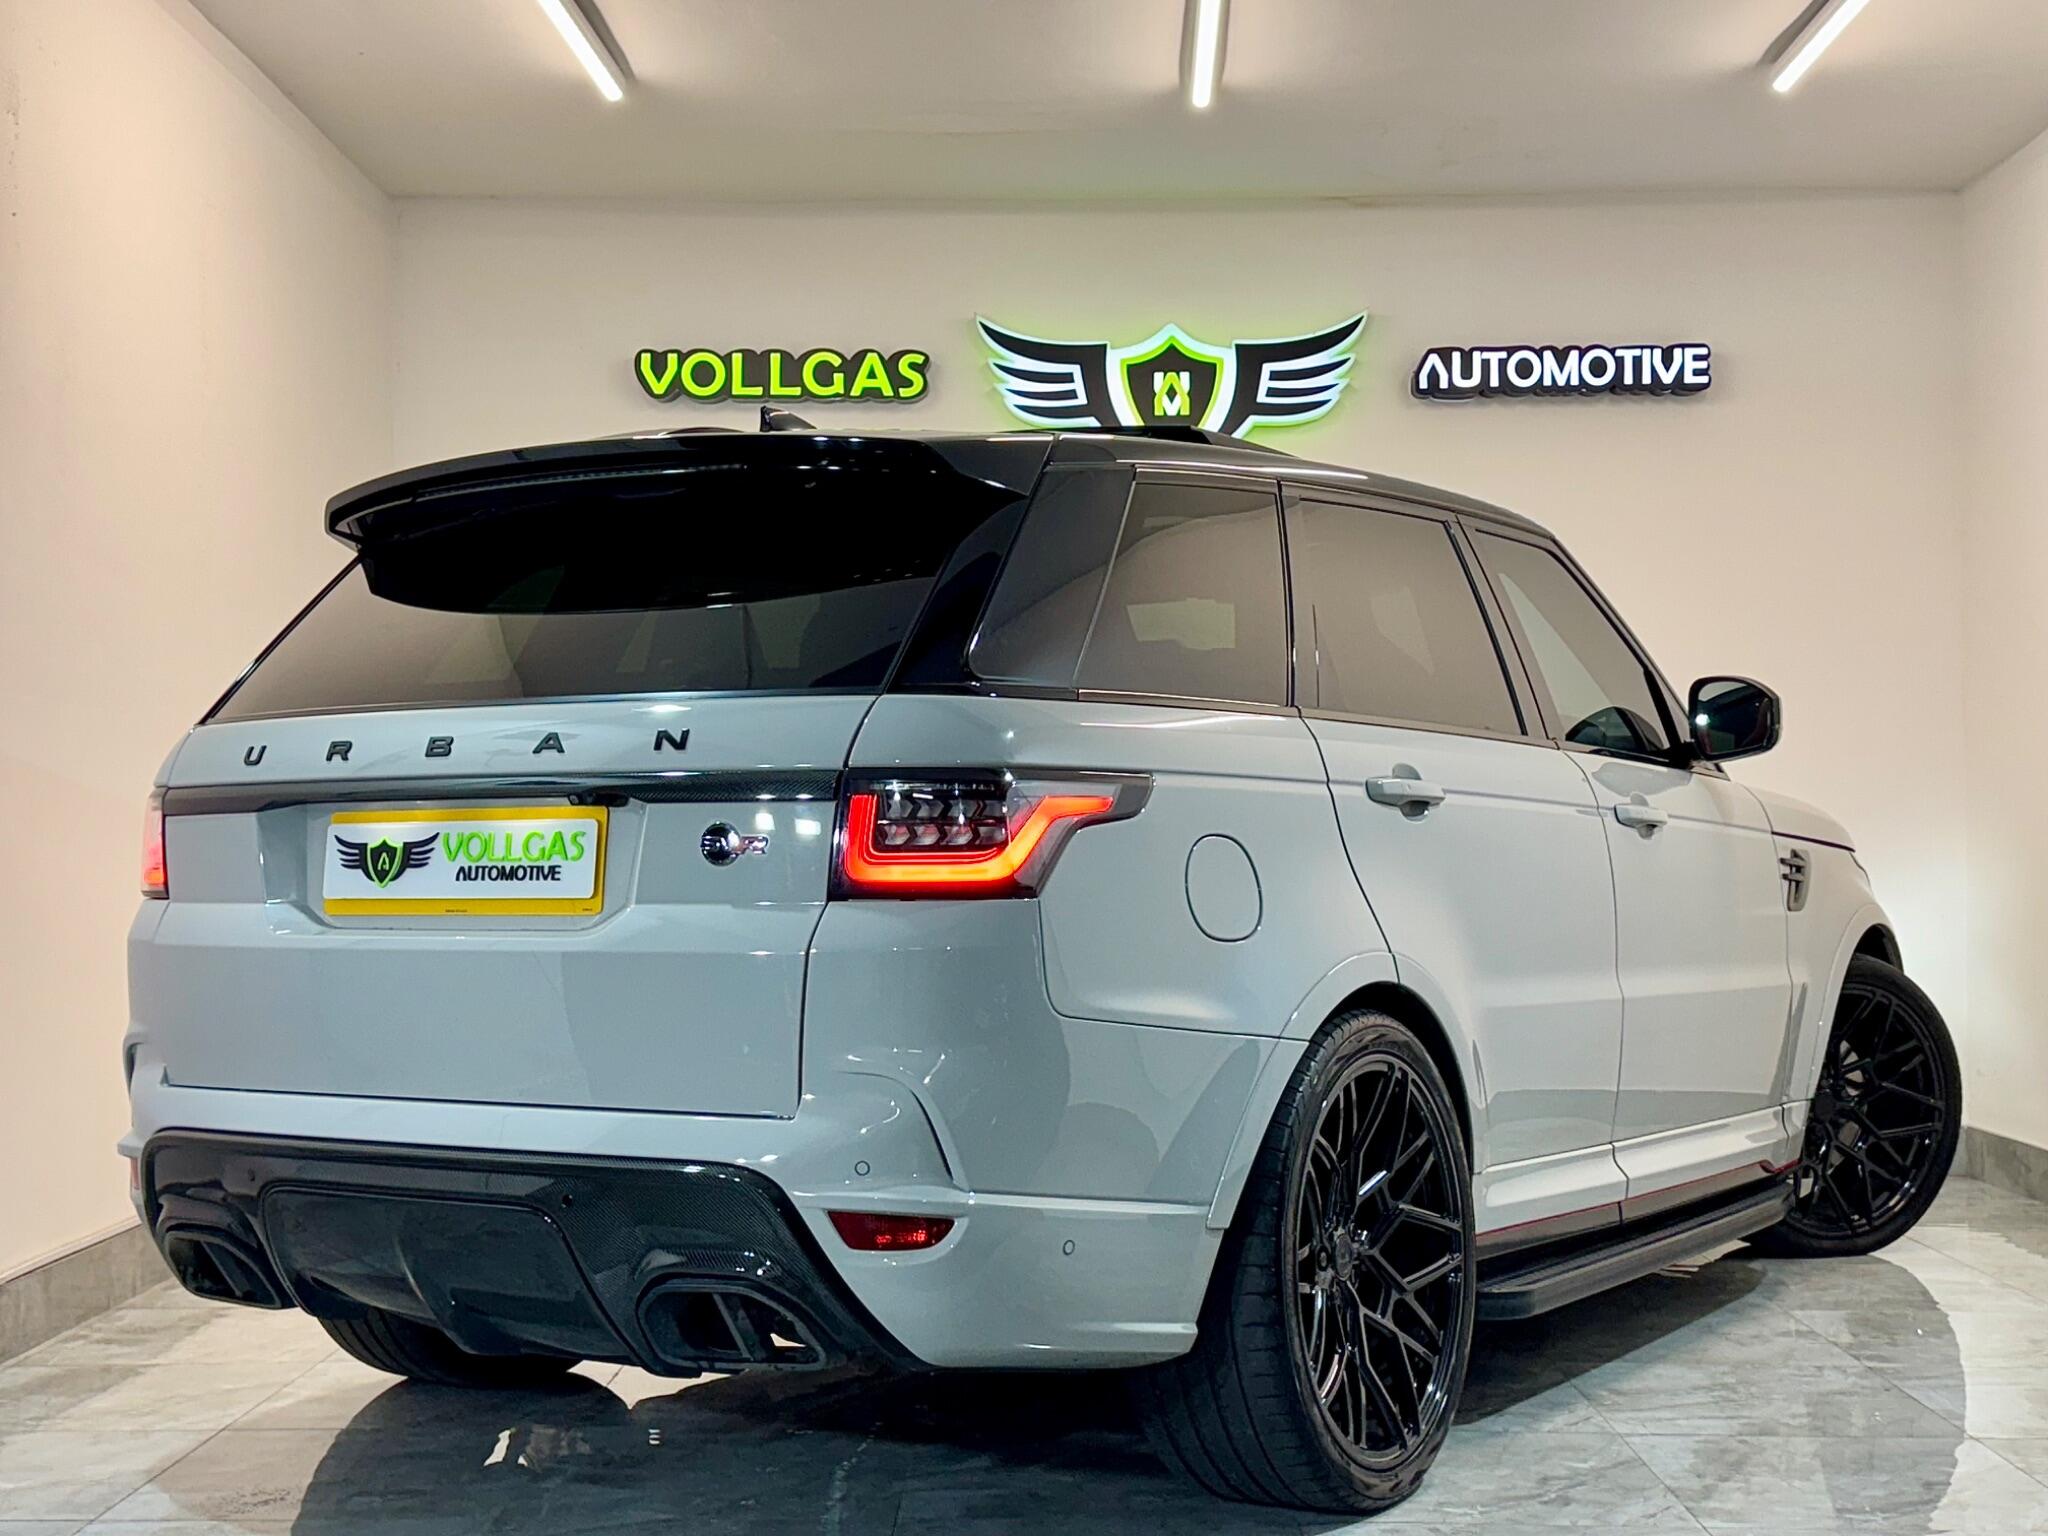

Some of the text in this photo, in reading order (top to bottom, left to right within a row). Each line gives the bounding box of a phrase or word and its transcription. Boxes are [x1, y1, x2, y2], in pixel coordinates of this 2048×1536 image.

[639, 351, 929, 398] VOLLGAS
[1417, 345, 1711, 391] AUTOMOTIVE
[242, 727, 690, 766] URBAN
[442, 830, 587, 863] VOLLGAS
[455, 864, 562, 882] AUTOMOTIVE
